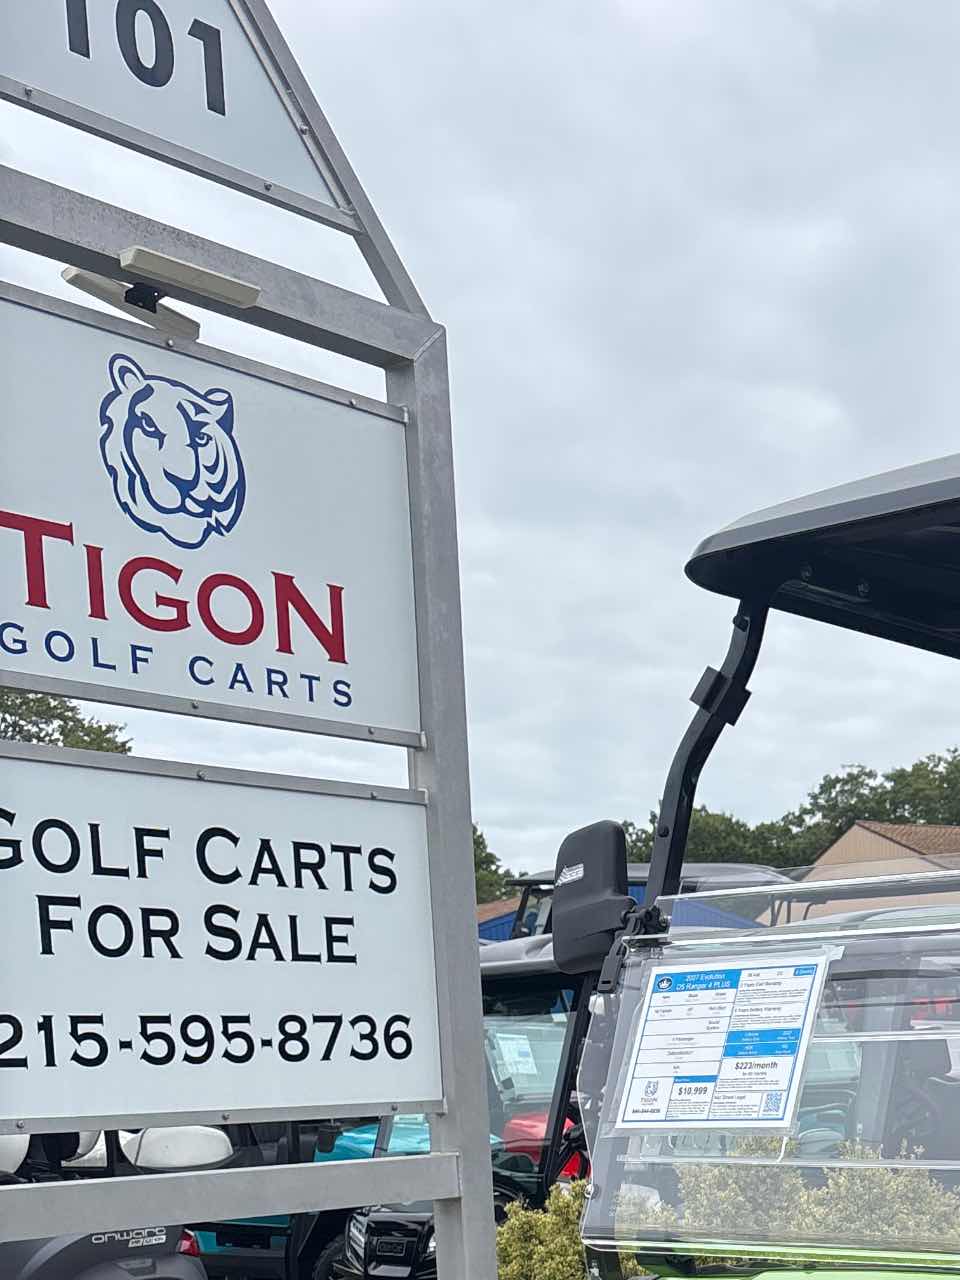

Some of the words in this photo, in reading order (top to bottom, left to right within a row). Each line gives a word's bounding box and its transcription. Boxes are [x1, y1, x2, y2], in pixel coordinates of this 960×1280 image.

[66, 0, 226, 117] 101
[0, 510, 347, 663] TIGON
[0, 621, 154, 675] GOLF
[188, 655, 353, 708] CARTS
[195, 826, 398, 895] CARTS
[35, 894, 183, 959] FOR
[203, 903, 358, 964] SALE
[0, 1011, 414, 1070] 215-595-8736
